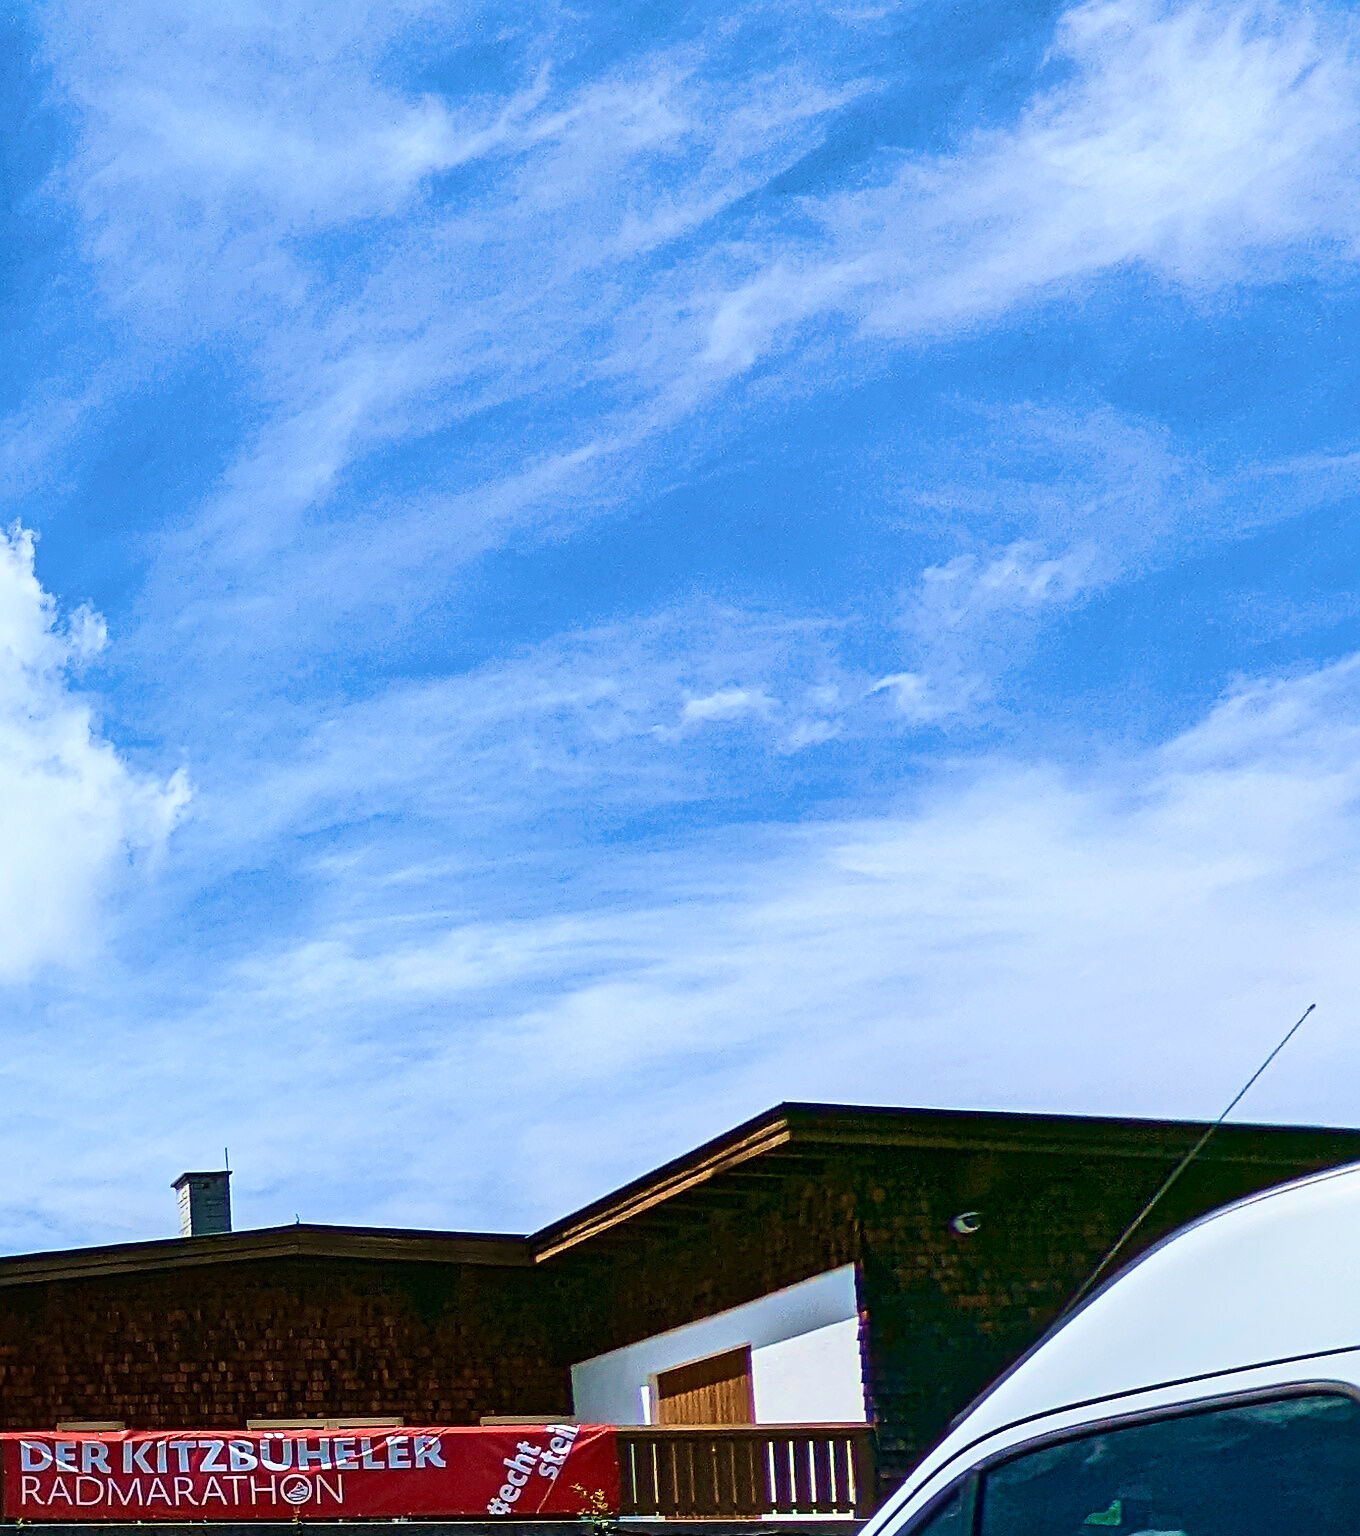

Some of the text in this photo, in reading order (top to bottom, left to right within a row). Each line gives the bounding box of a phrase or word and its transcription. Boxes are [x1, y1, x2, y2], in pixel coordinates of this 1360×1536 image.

[19, 1432, 447, 1475] DER KITZBÜHELER
[539, 1424, 580, 1480] steil
[20, 1473, 344, 1507] RADMARATHON
[487, 1441, 541, 1515] #echt
